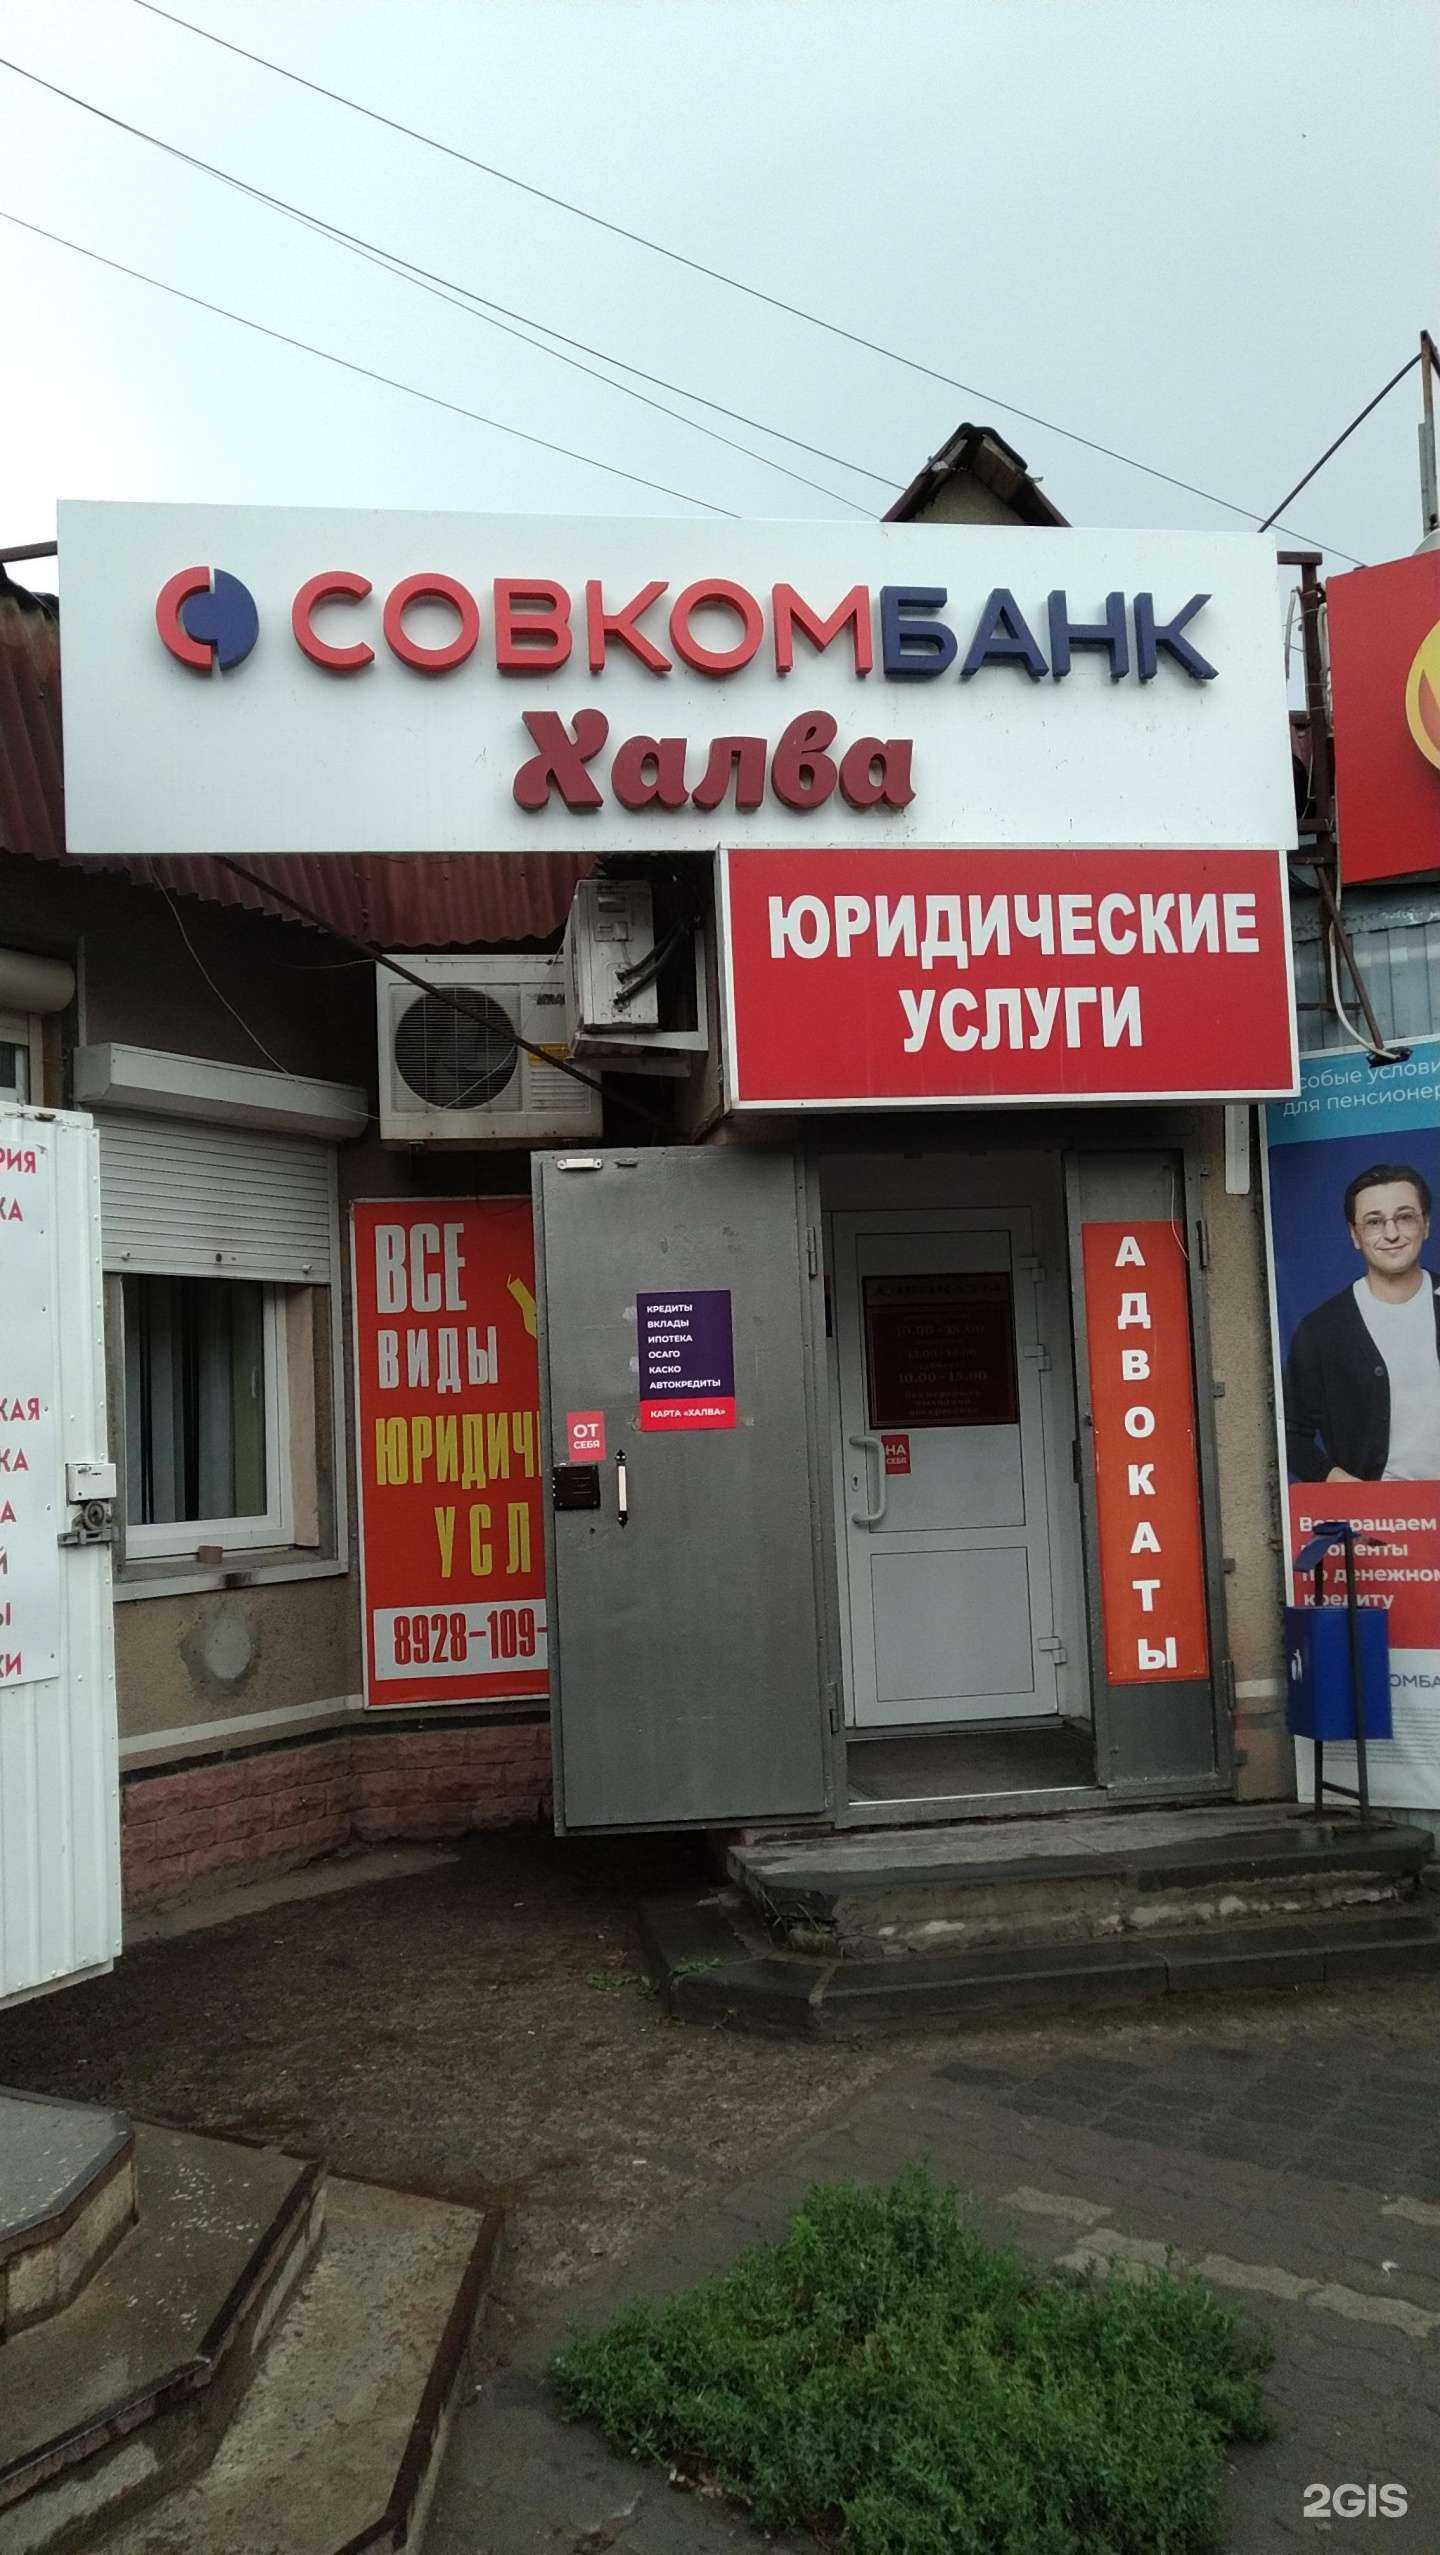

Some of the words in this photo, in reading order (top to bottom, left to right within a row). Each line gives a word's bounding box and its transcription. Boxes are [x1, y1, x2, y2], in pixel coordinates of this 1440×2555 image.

[292, 571, 1218, 681] СОВКОМБАНК
[513, 709, 917, 812] Халва
[768, 894, 1260, 968] ЮРИДИЧЕСКИЕ
[899, 987, 1143, 1053] УСЛУГИ
[1300, 1069, 1362, 1089] собые
[1283, 1099, 1320, 1117] для
[375, 1223, 467, 1313] ВСЕ
[647, 1304, 693, 1314] КРЕДИТЫ
[647, 1319, 690, 1329] ВКЛАДЫ
[648, 1335, 693, 1344] ИПОТЕКА
[378, 1326, 498, 1393] ВИДЫ
[648, 1350, 681, 1359] ОСАГО
[648, 1365, 682, 1374] КАСКО
[649, 1379, 721, 1389] АВТОКРЕДИТЫ
[650, 1409, 681, 1418] КАРТА
[684, 1408, 726, 1417] «ХАЛВА»
[573, 1423, 598, 1438] ОТ
[375, 1411, 542, 1490] ЮРИДИЧ
[573, 1440, 600, 1450] СЕБЯ
[885, 1444, 906, 1456] НА
[1115, 1236, 1177, 1669] АДВОКАТЫ
[1299, 1517, 1438, 1532] Вращаем
[434, 1502, 532, 1578] УСЛ
